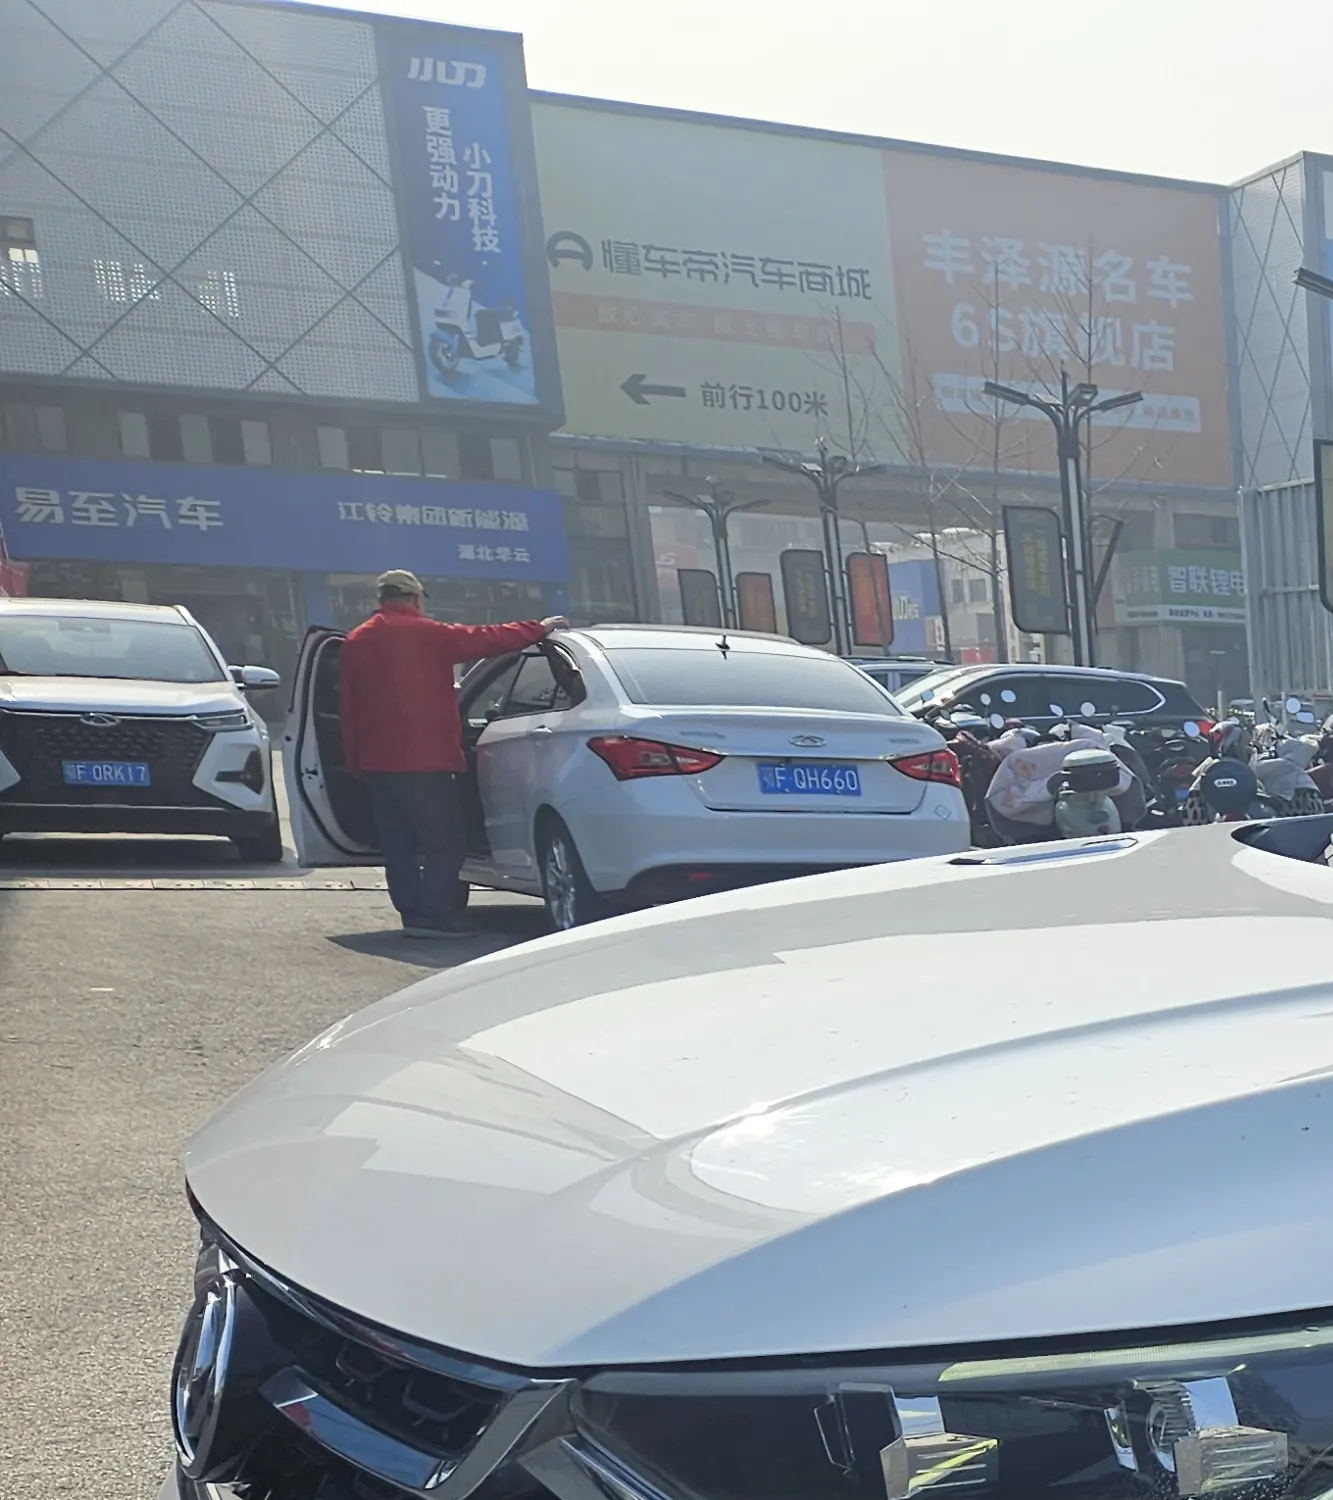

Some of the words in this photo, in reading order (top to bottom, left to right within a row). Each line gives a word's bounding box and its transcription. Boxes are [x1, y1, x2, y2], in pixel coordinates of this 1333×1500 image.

[421, 105, 461, 222] 更强动力
[462, 141, 502, 254] 小刀科技
[600, 237, 873, 301] 懂车帝汽车商城
[921, 228, 1195, 310] 丰泽源名车
[951, 300, 1176, 373] 6S旗舰店
[700, 380, 829, 418] 前行100米
[14, 486, 225, 532] 易至汽车
[337, 500, 530, 533] 江铃集团新能源
